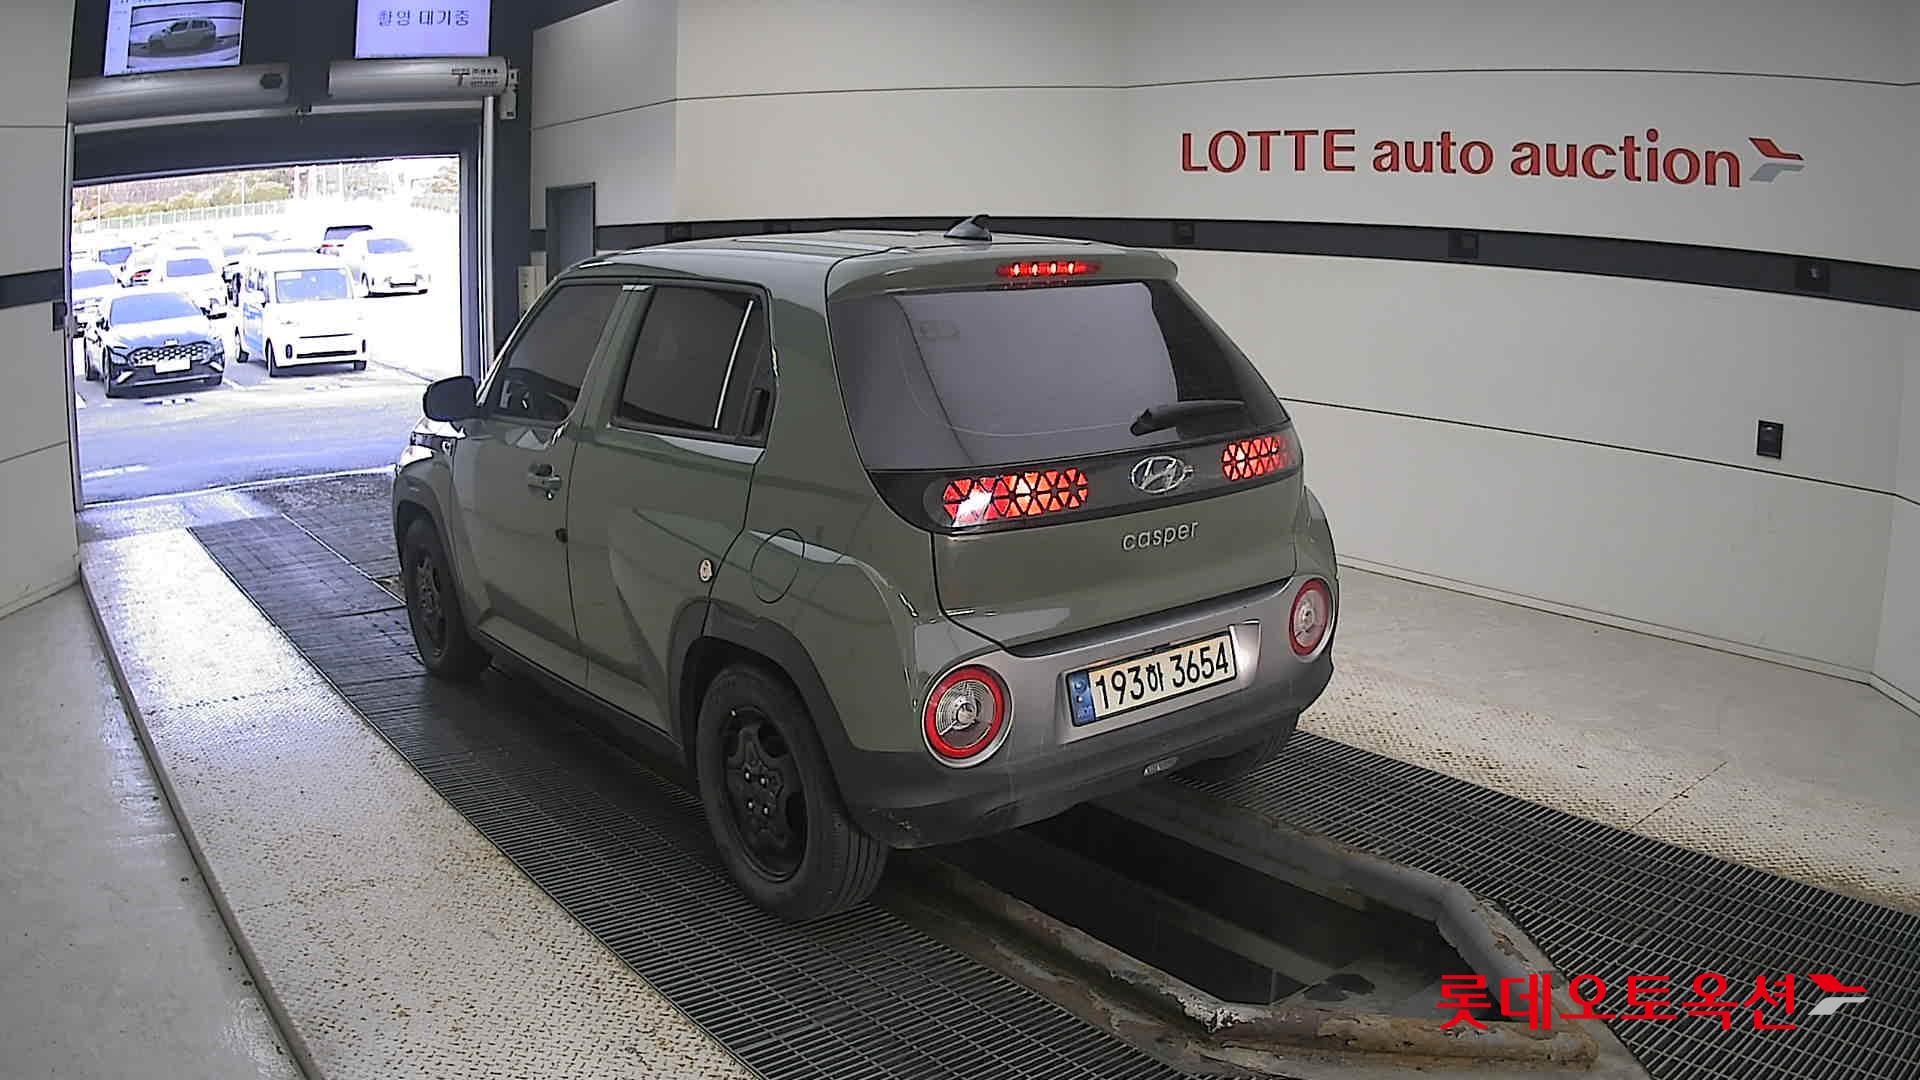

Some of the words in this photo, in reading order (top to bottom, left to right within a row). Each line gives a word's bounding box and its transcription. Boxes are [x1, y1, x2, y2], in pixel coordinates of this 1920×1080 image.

[419, 10, 469, 26] 대기중
[1182, 129, 1356, 173] LOTTE
[1372, 131, 1494, 175] auto
[1510, 128, 1740, 188] auction
[1122, 521, 1199, 550] casper
[1095, 661, 1164, 709] 193하
[1169, 641, 1229, 688] 3654
